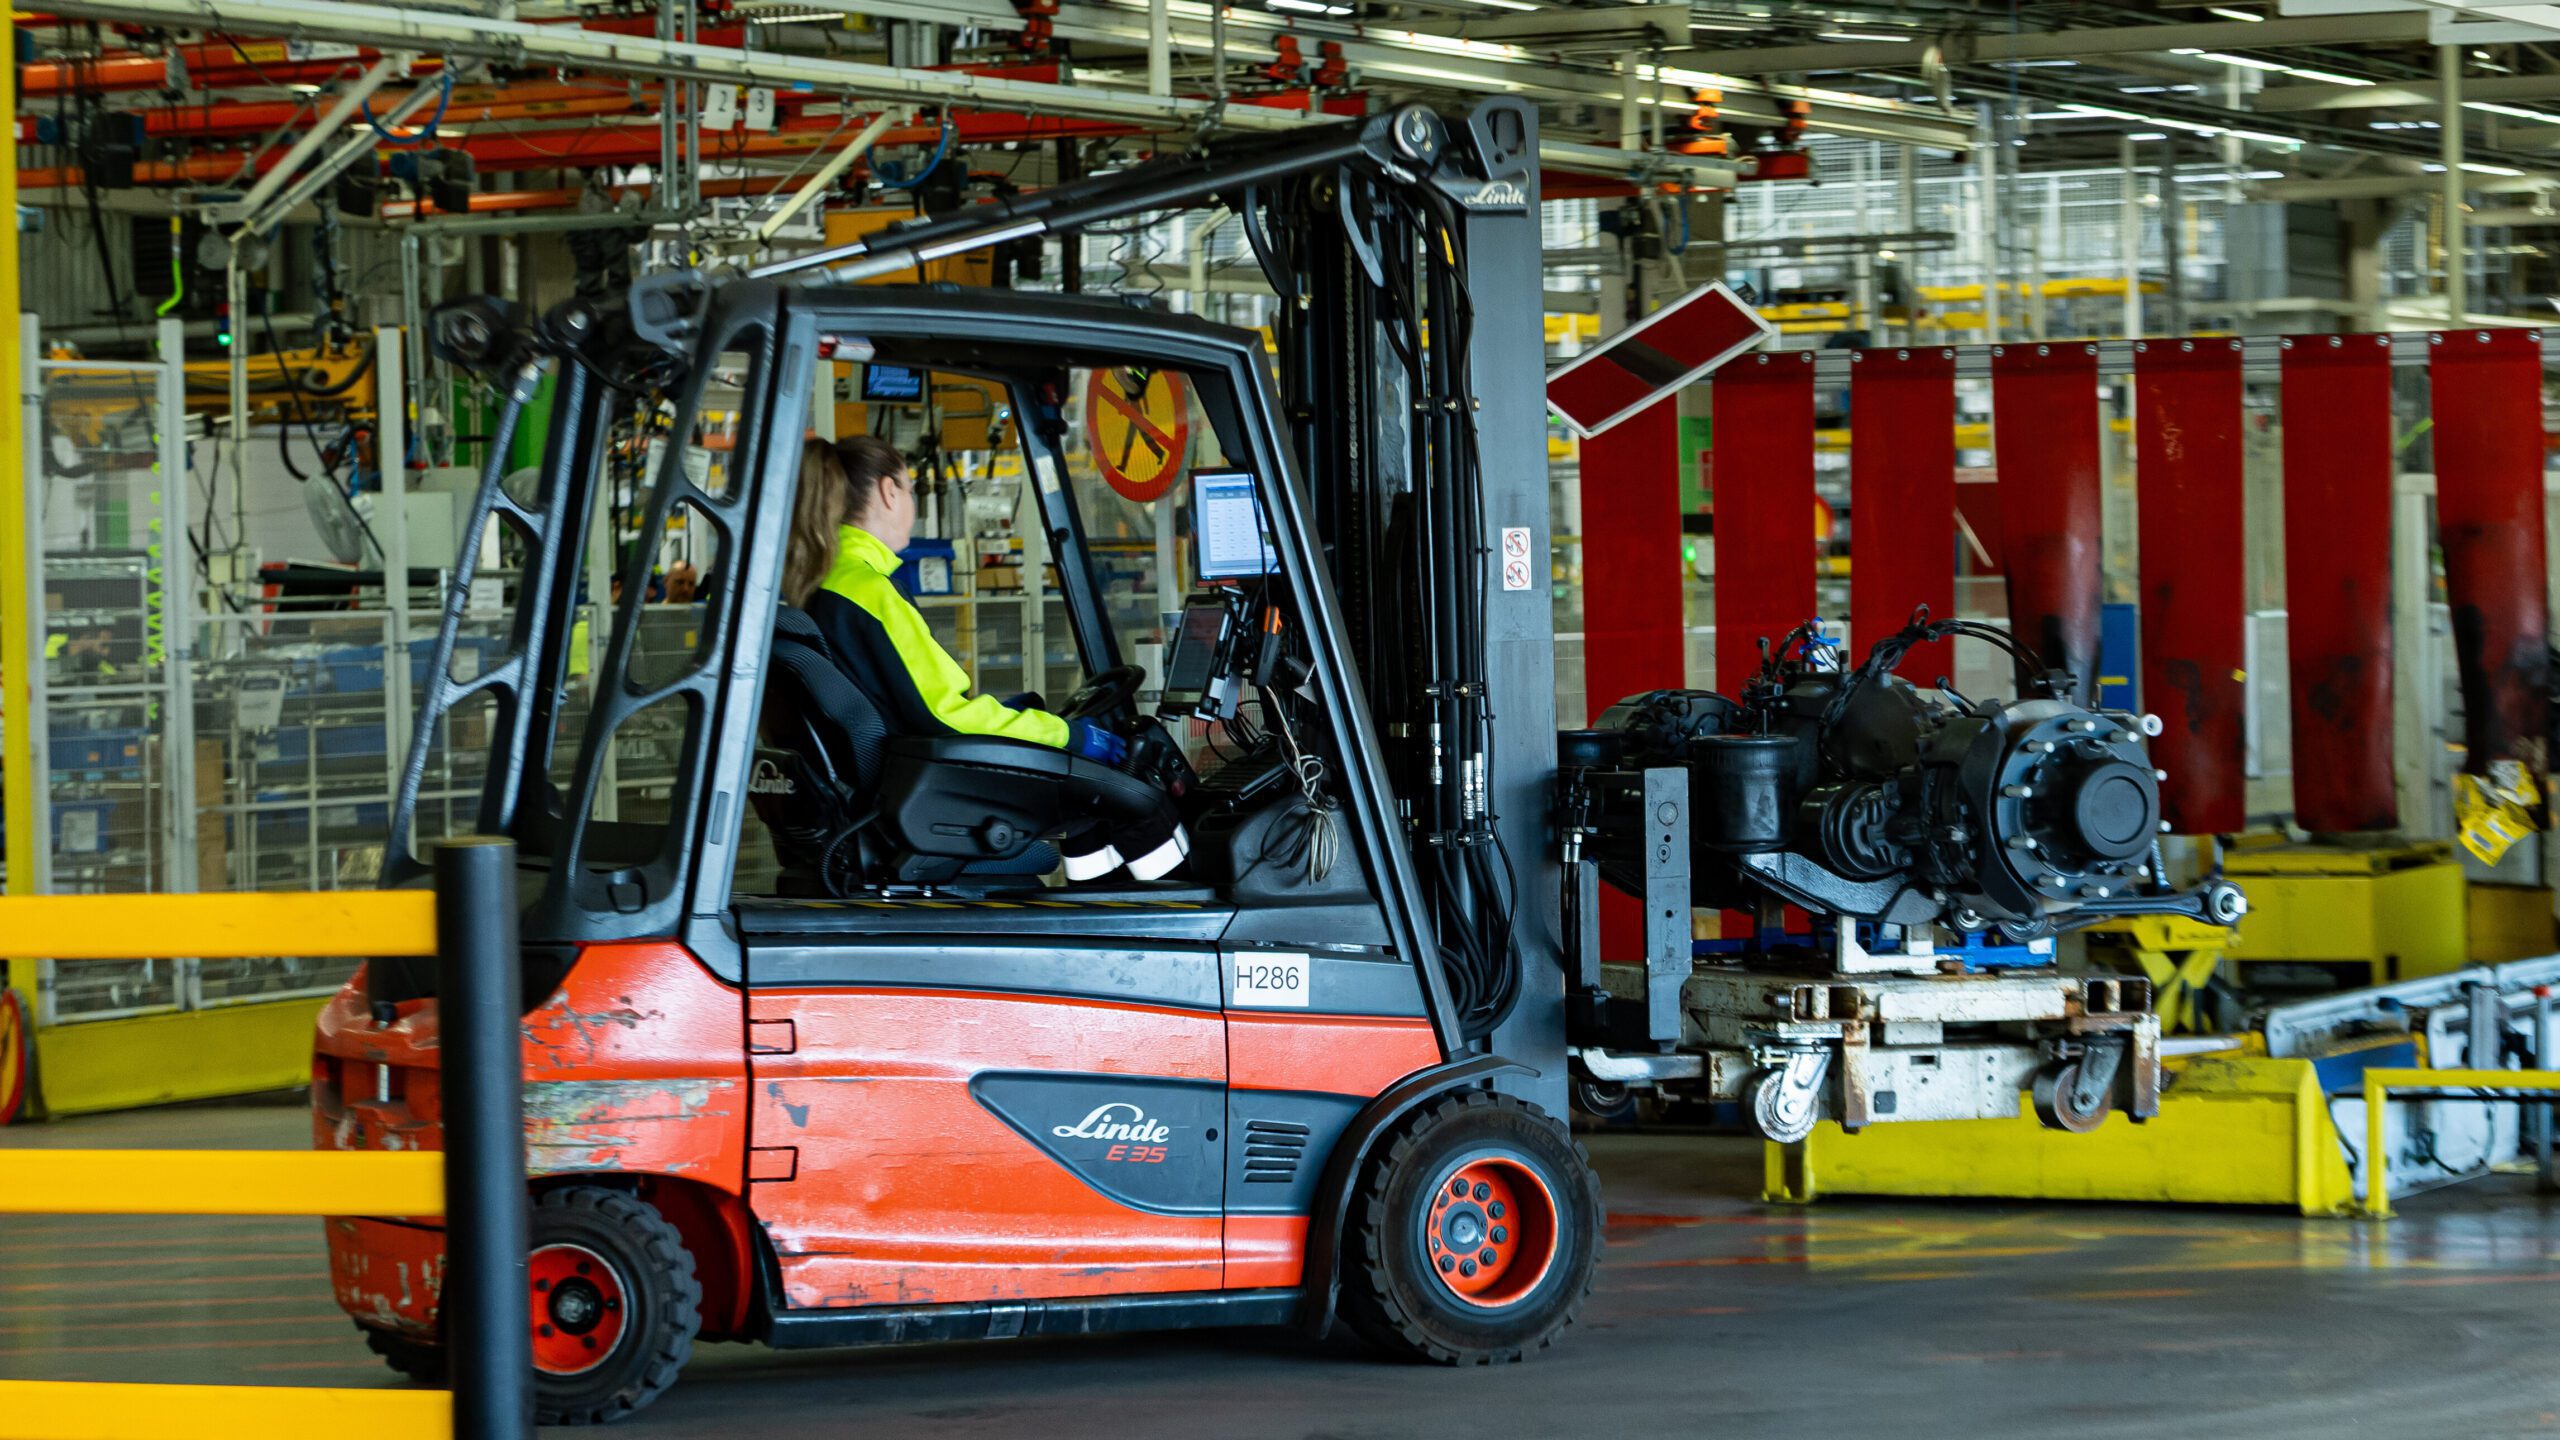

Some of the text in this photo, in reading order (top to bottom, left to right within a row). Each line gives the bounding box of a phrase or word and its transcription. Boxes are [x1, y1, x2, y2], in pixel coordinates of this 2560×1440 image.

[718, 90, 728, 112] 2
[757, 90, 766, 112] 3
[1463, 180, 1526, 204] Linde
[748, 759, 797, 793] Linde
[1236, 965, 1299, 990] H286
[1052, 1102, 1170, 1143] Linde
[1105, 1145, 1169, 1163] E 35
